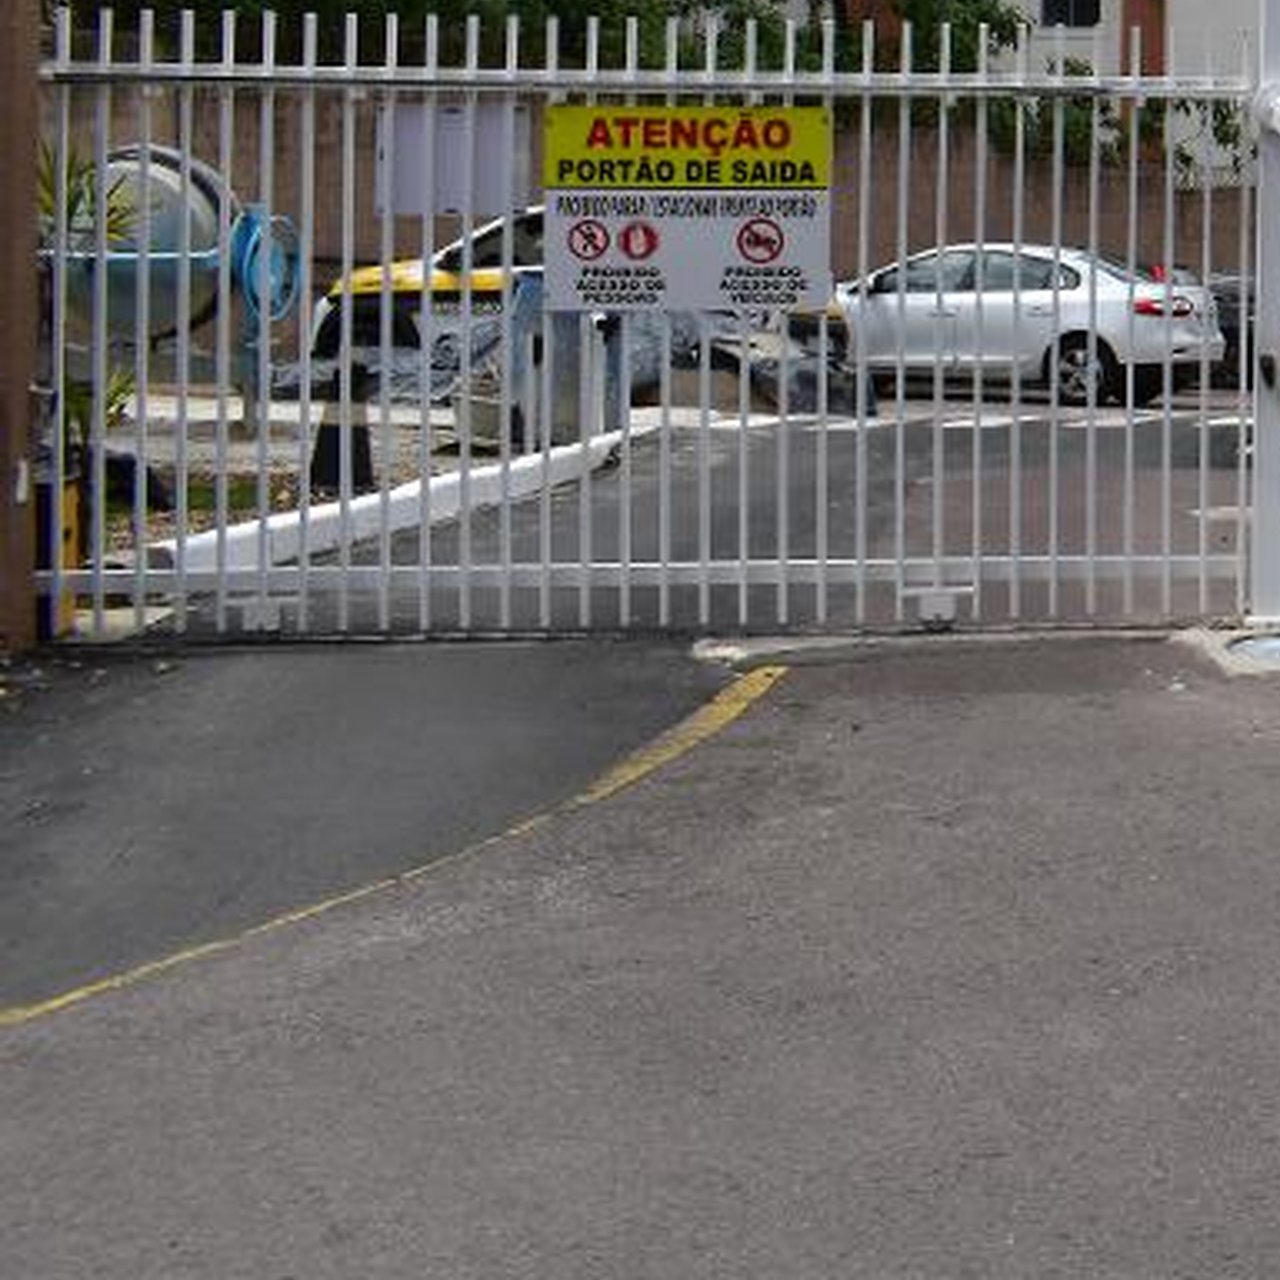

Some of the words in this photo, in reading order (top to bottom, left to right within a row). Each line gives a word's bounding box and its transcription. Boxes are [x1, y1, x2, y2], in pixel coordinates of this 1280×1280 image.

[586, 113, 791, 156] ATENÇÃO
[558, 155, 674, 183] PORTÃO
[685, 160, 721, 183] DE
[731, 160, 816, 183] SAIDA
